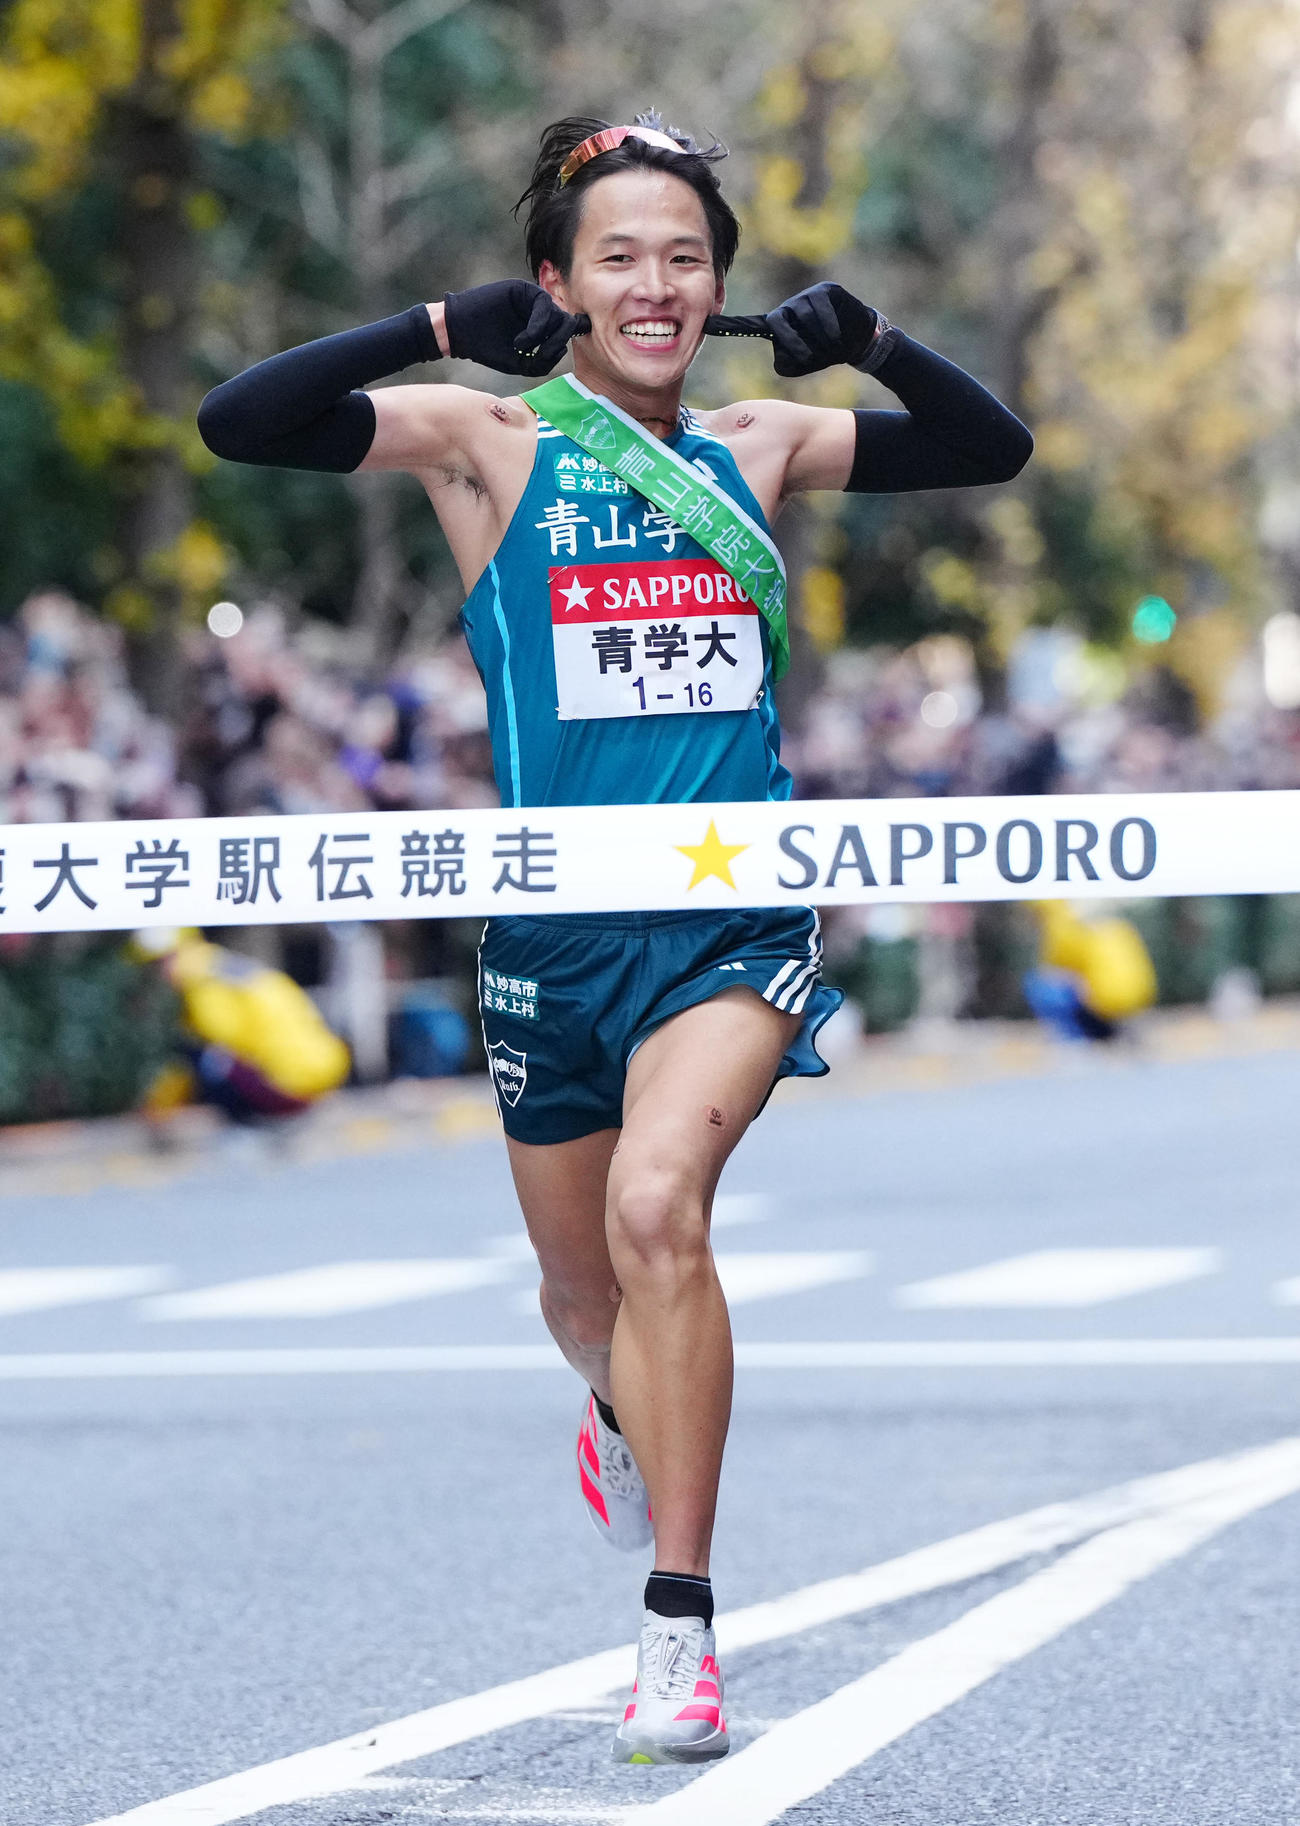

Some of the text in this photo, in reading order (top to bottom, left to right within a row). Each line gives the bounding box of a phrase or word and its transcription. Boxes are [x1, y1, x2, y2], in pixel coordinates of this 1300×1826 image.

[581, 476, 628, 494] 水上村
[614, 442, 786, 617] 青山学院大学
[591, 621, 738, 674] 青学大
[0, 826, 557, 914] 大学駅伝競走
[777, 817, 1157, 890] SAPPORO
[495, 995, 535, 1018] 水上村
[496, 974, 537, 998] 妙高市
